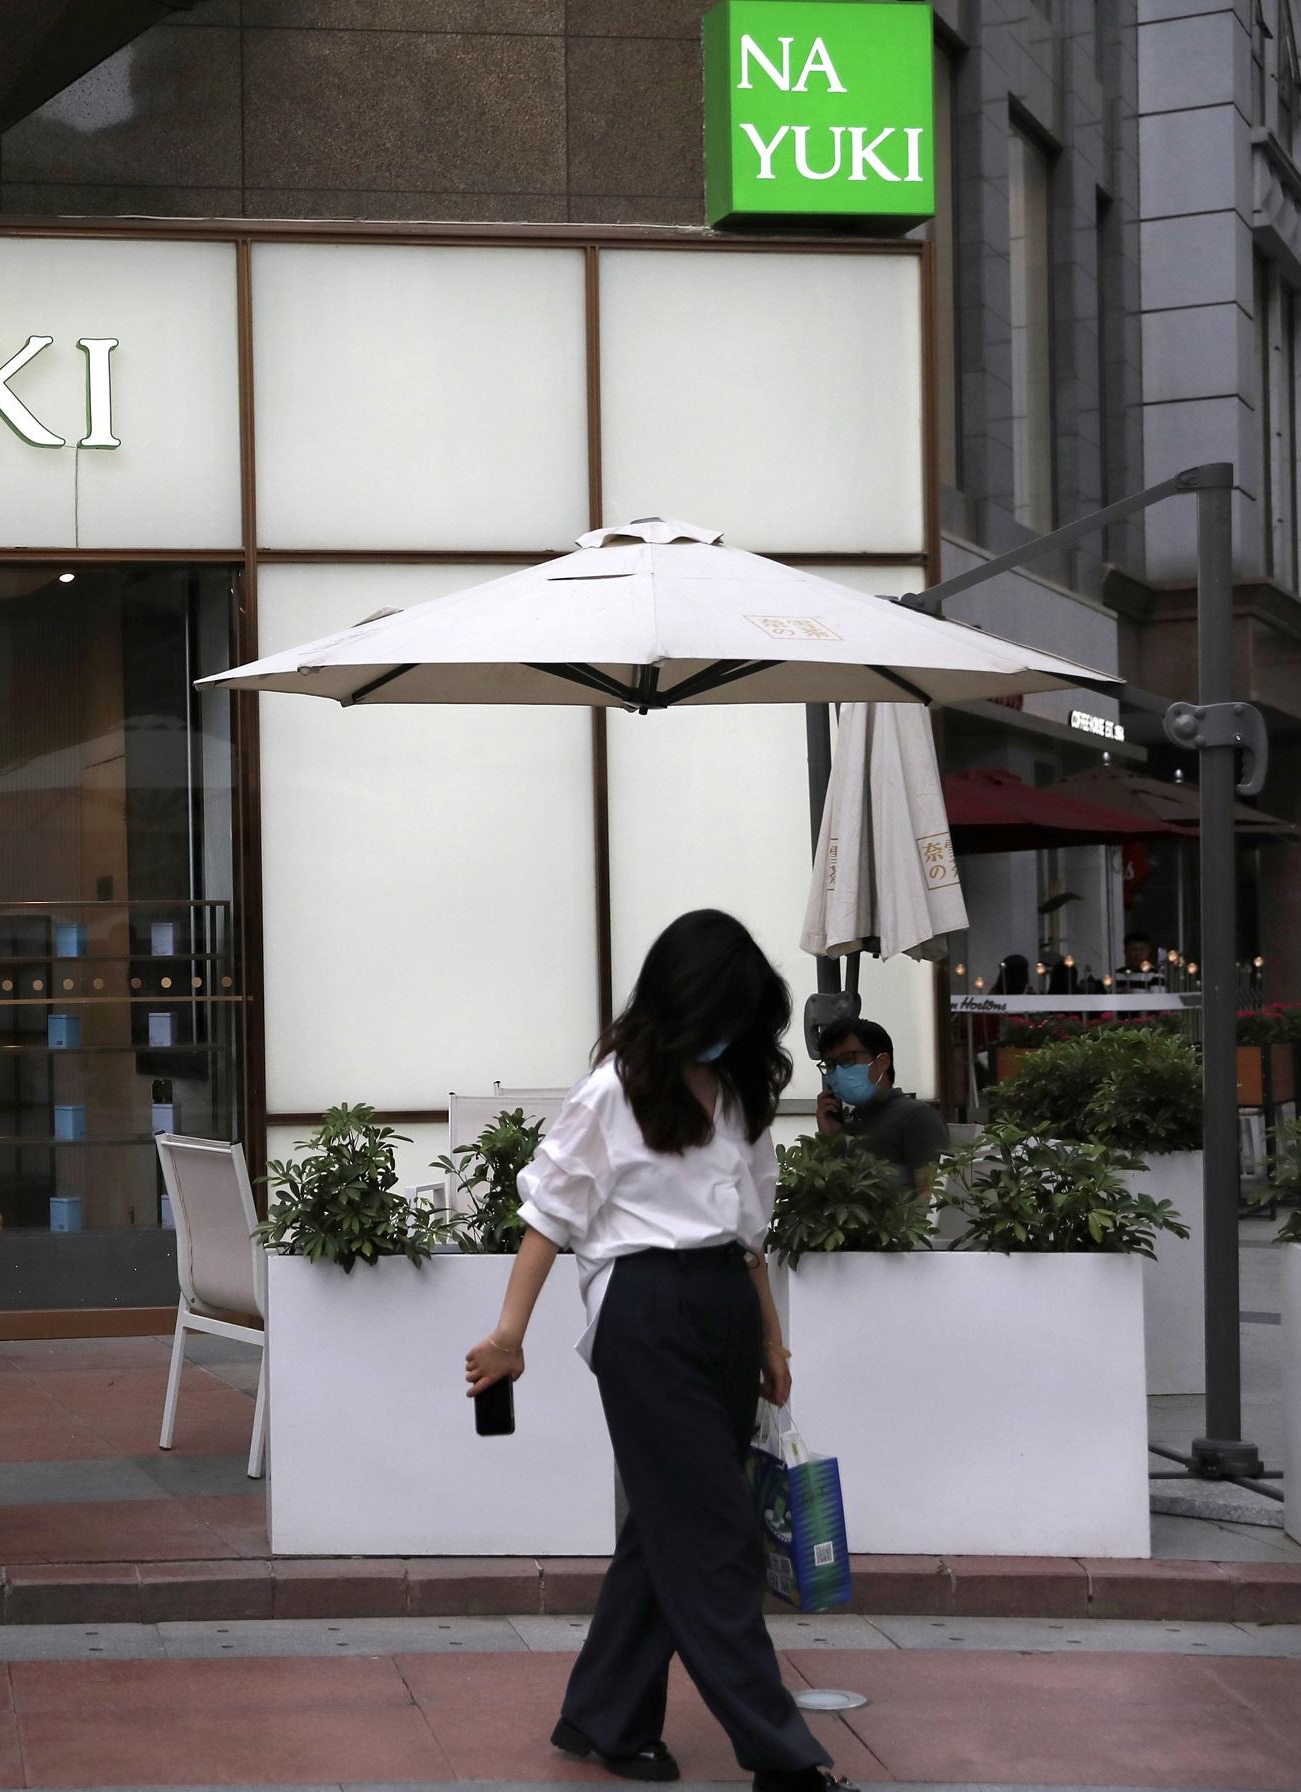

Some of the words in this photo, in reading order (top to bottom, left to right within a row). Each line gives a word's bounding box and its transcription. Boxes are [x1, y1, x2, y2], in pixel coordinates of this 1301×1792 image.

[737, 34, 847, 93] NA
[739, 123, 924, 182] YUKI
[960, 996, 1007, 1011] Hortons
